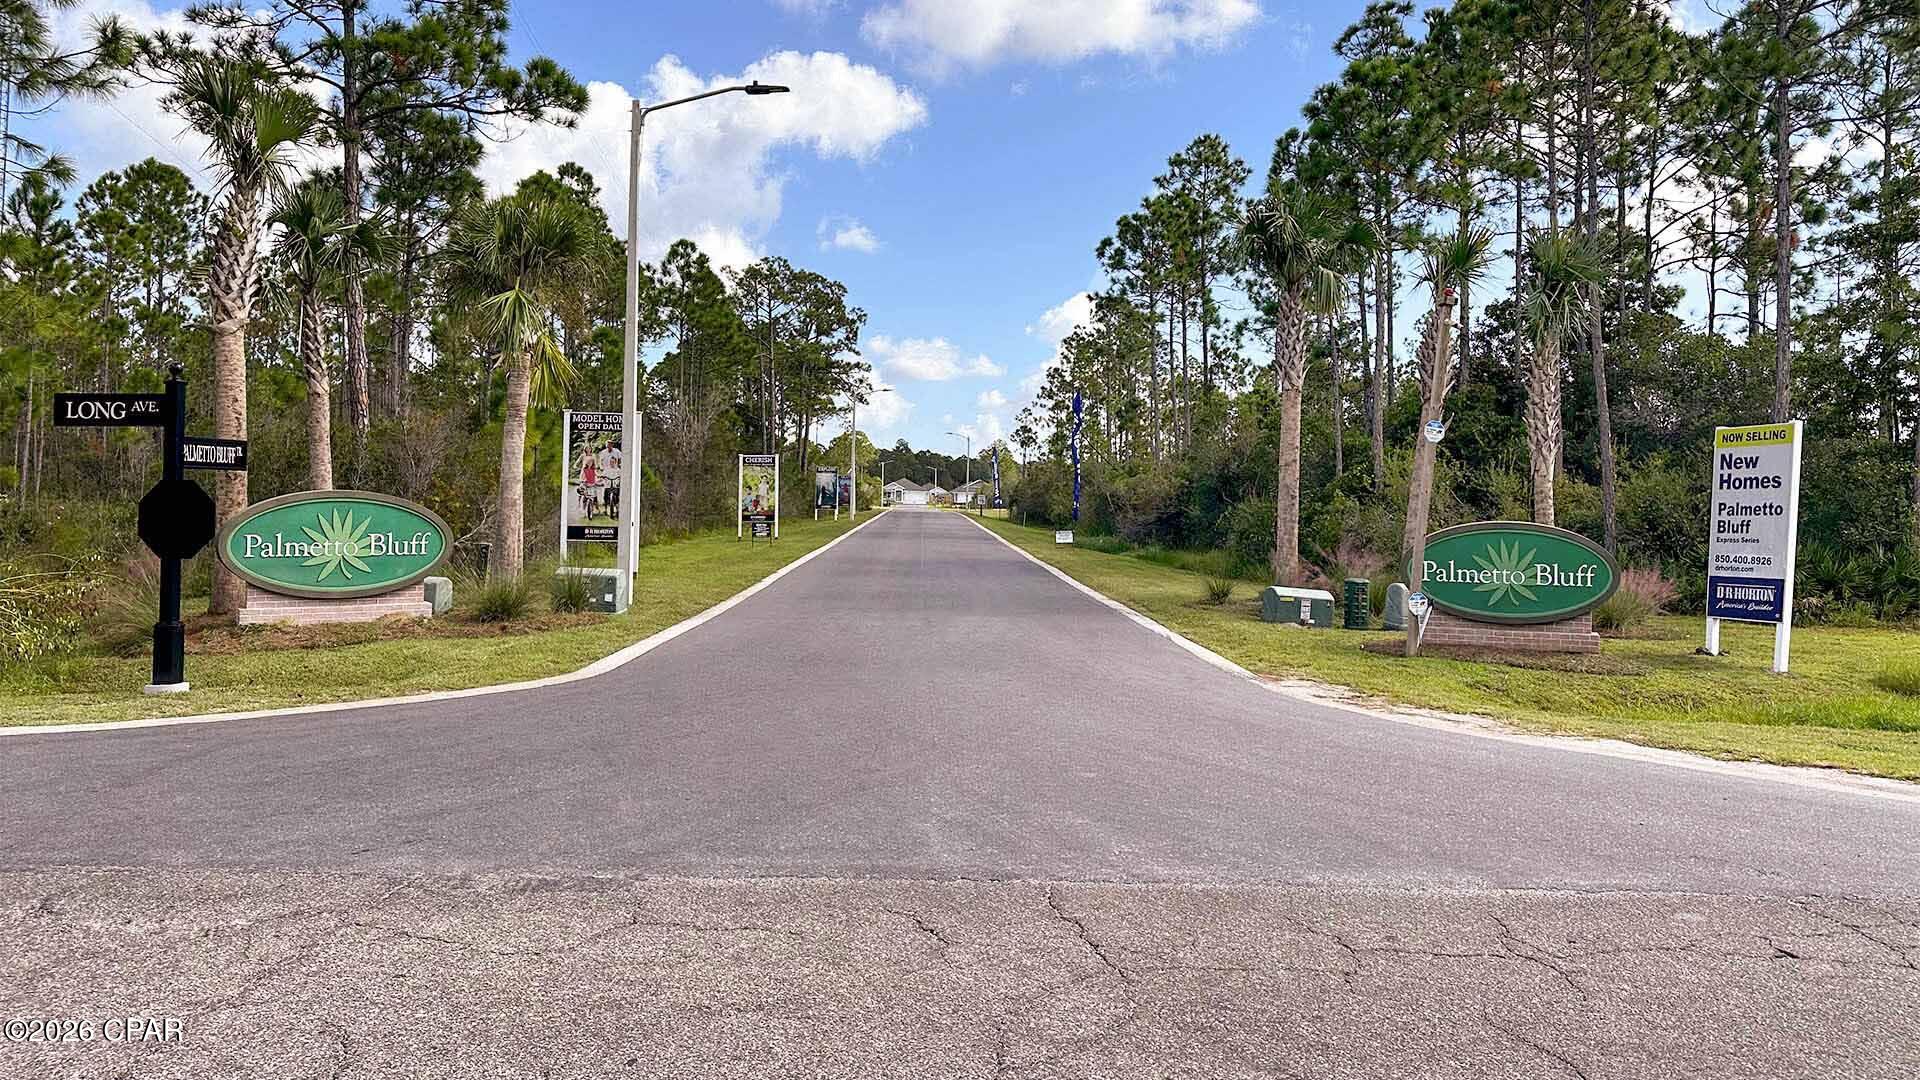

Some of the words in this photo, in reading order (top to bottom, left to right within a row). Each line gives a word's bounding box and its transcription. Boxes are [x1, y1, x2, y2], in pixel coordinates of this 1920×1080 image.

[65, 401, 127, 420] LONG
[131, 402, 160, 413] AVE.
[572, 414, 604, 423] MODEL
[1721, 432, 1744, 443] NOW
[1745, 429, 1787, 442] SELLING
[216, 446, 236, 464] BLUFF
[1720, 453, 1760, 470] New
[1719, 473, 1782, 490] Homes
[1718, 502, 1784, 517] Palmetto
[1717, 519, 1752, 534] Bluff
[243, 533, 359, 558] Palmetto
[367, 532, 431, 556] Bluff
[1714, 554, 1772, 566] 850.400.8926
[1422, 560, 1526, 585] Palmetto
[1534, 563, 1598, 587] Bluff
[1714, 565, 1754, 573] drhorton.com
